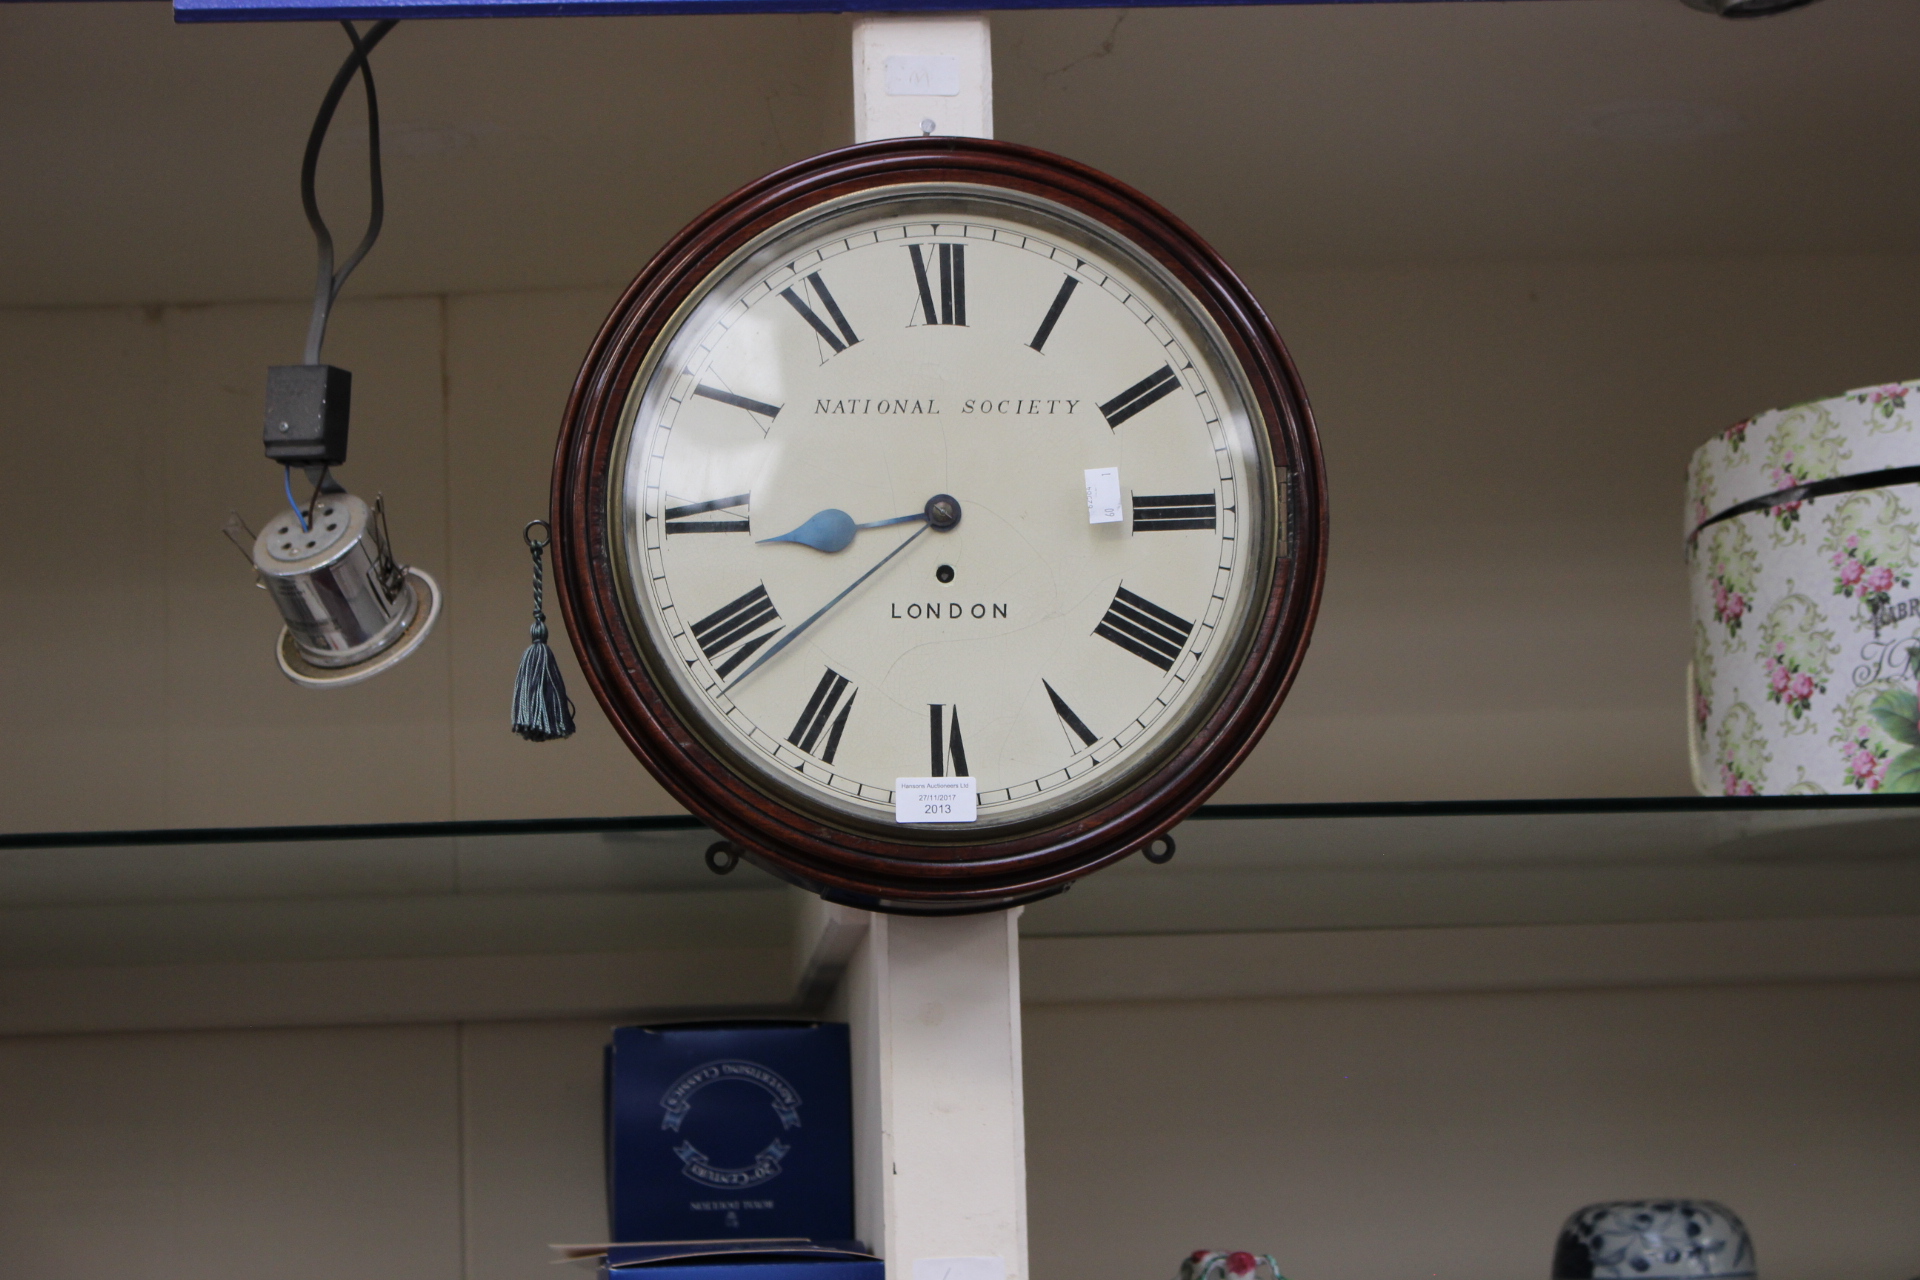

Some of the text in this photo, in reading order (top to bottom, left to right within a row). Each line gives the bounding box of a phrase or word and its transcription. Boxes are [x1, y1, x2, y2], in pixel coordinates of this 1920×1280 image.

[776, 269, 864, 366] XI
[899, 243, 970, 328] XII
[1024, 272, 1083, 356] I
[690, 361, 785, 438] X
[814, 398, 1080, 415] NATIONAL SOCIETY
[1095, 360, 1184, 434] II
[665, 490, 751, 540] IX
[1131, 489, 1216, 536] III
[686, 579, 786, 683] VIII
[891, 603, 1008, 619] LONDON
[1090, 579, 1196, 678] IIII
[784, 665, 859, 766] VII
[927, 703, 970, 777] VI
[1042, 677, 1103, 757] V
[924, 804, 952, 814] 2013
